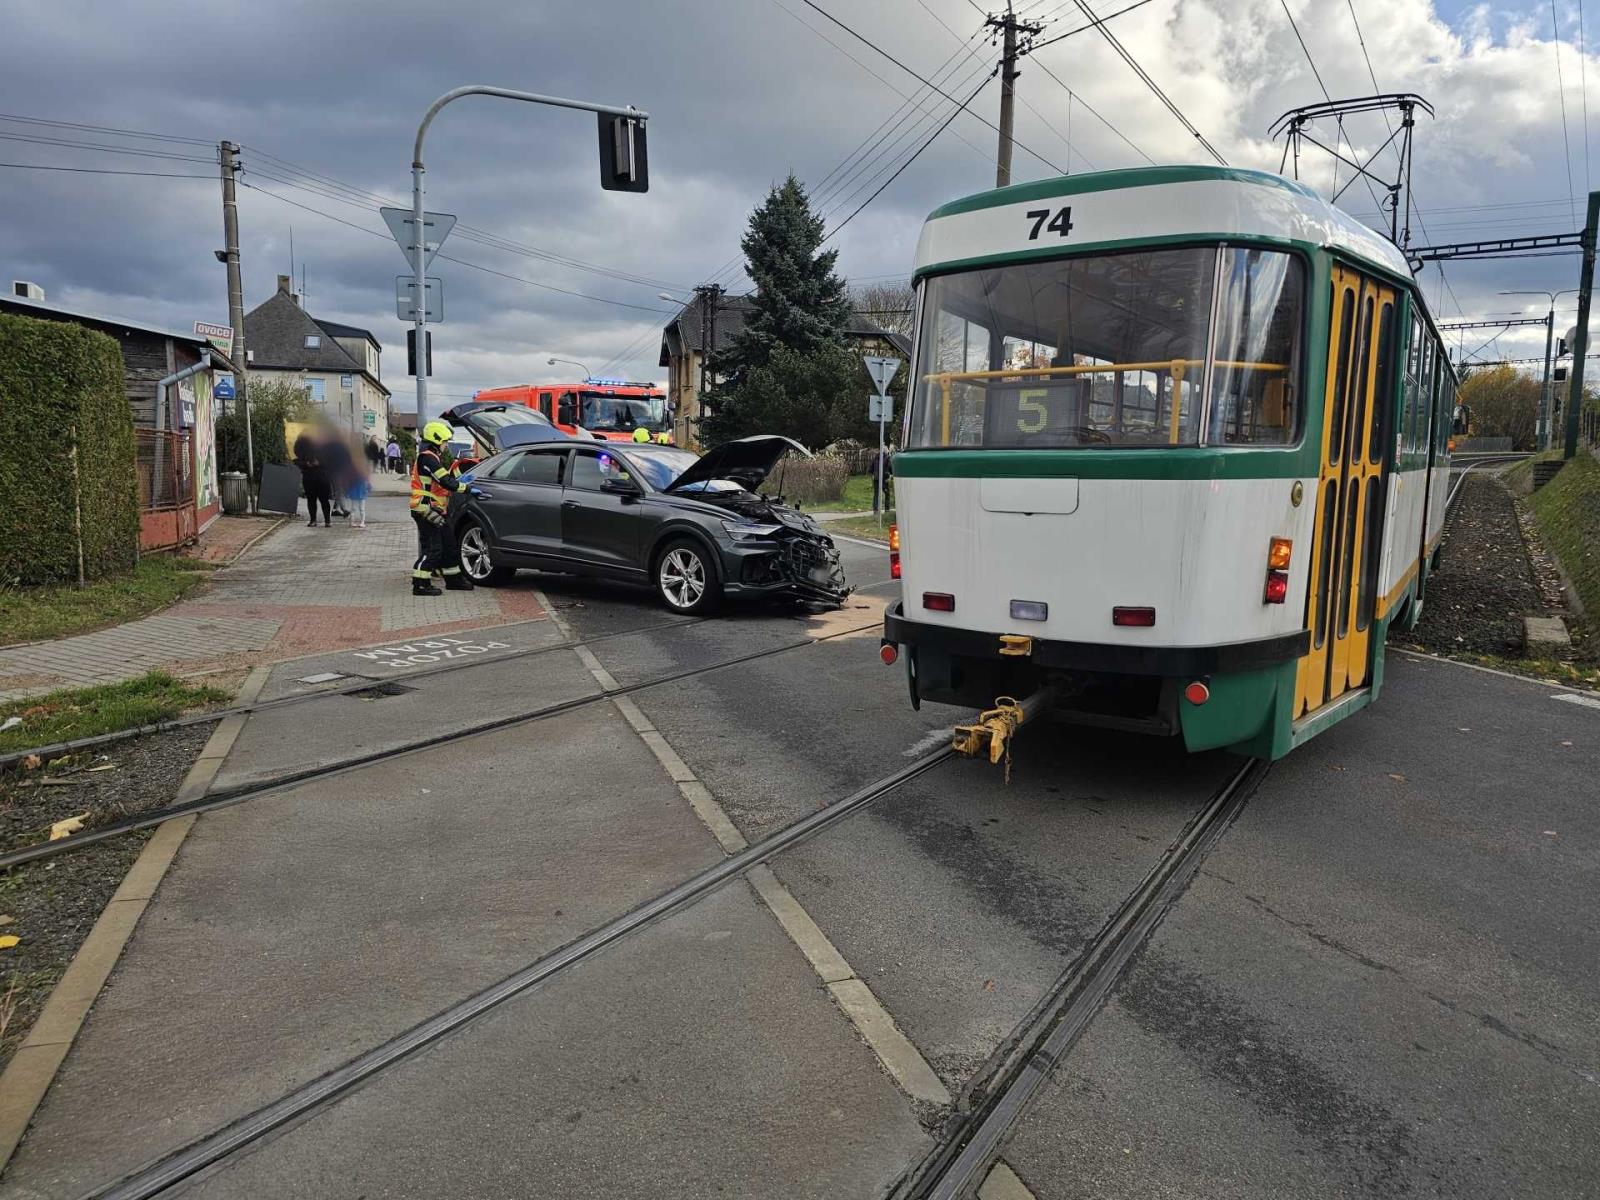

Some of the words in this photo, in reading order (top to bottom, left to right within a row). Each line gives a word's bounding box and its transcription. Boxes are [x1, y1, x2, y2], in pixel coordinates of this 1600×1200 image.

[1026, 206, 1074, 240] 74
[1016, 389, 1048, 433] 5
[352, 638, 474, 660] TRAM
[376, 641, 511, 667] POZOR
